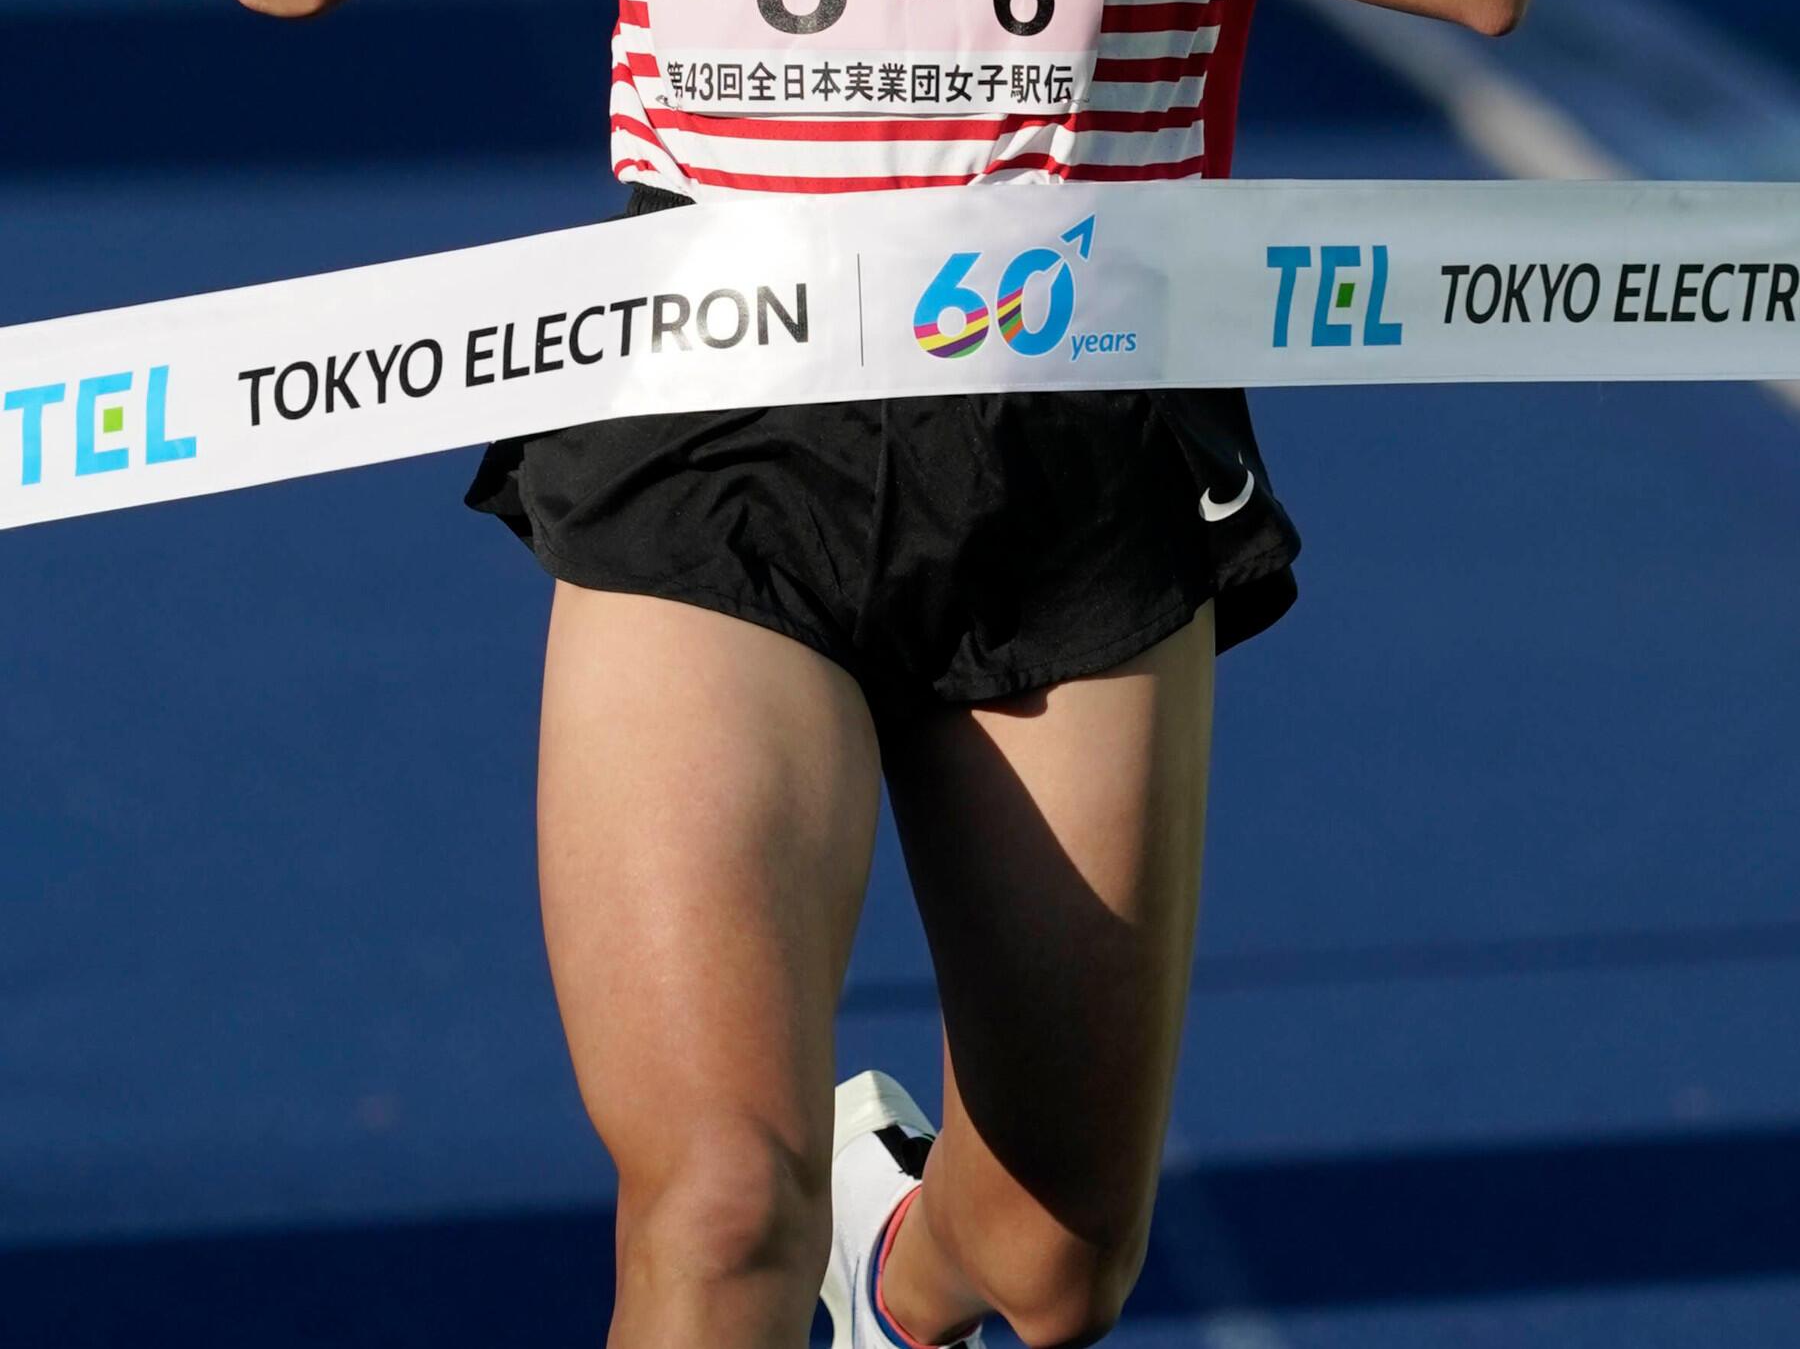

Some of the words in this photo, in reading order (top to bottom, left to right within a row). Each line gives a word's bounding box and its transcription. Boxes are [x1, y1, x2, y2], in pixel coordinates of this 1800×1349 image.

[667, 60, 1074, 105] 第43回全日本実業団女子駅伝
[913, 247, 1075, 358] 60
[1071, 331, 1137, 361] years
[1267, 244, 1403, 349] TEL
[1441, 263, 1600, 325] TOKYO
[1613, 262, 1800, 323] ELECTR
[3, 364, 197, 486] TEL
[238, 338, 443, 426] TOKYO
[465, 282, 810, 387] ELECTRON
